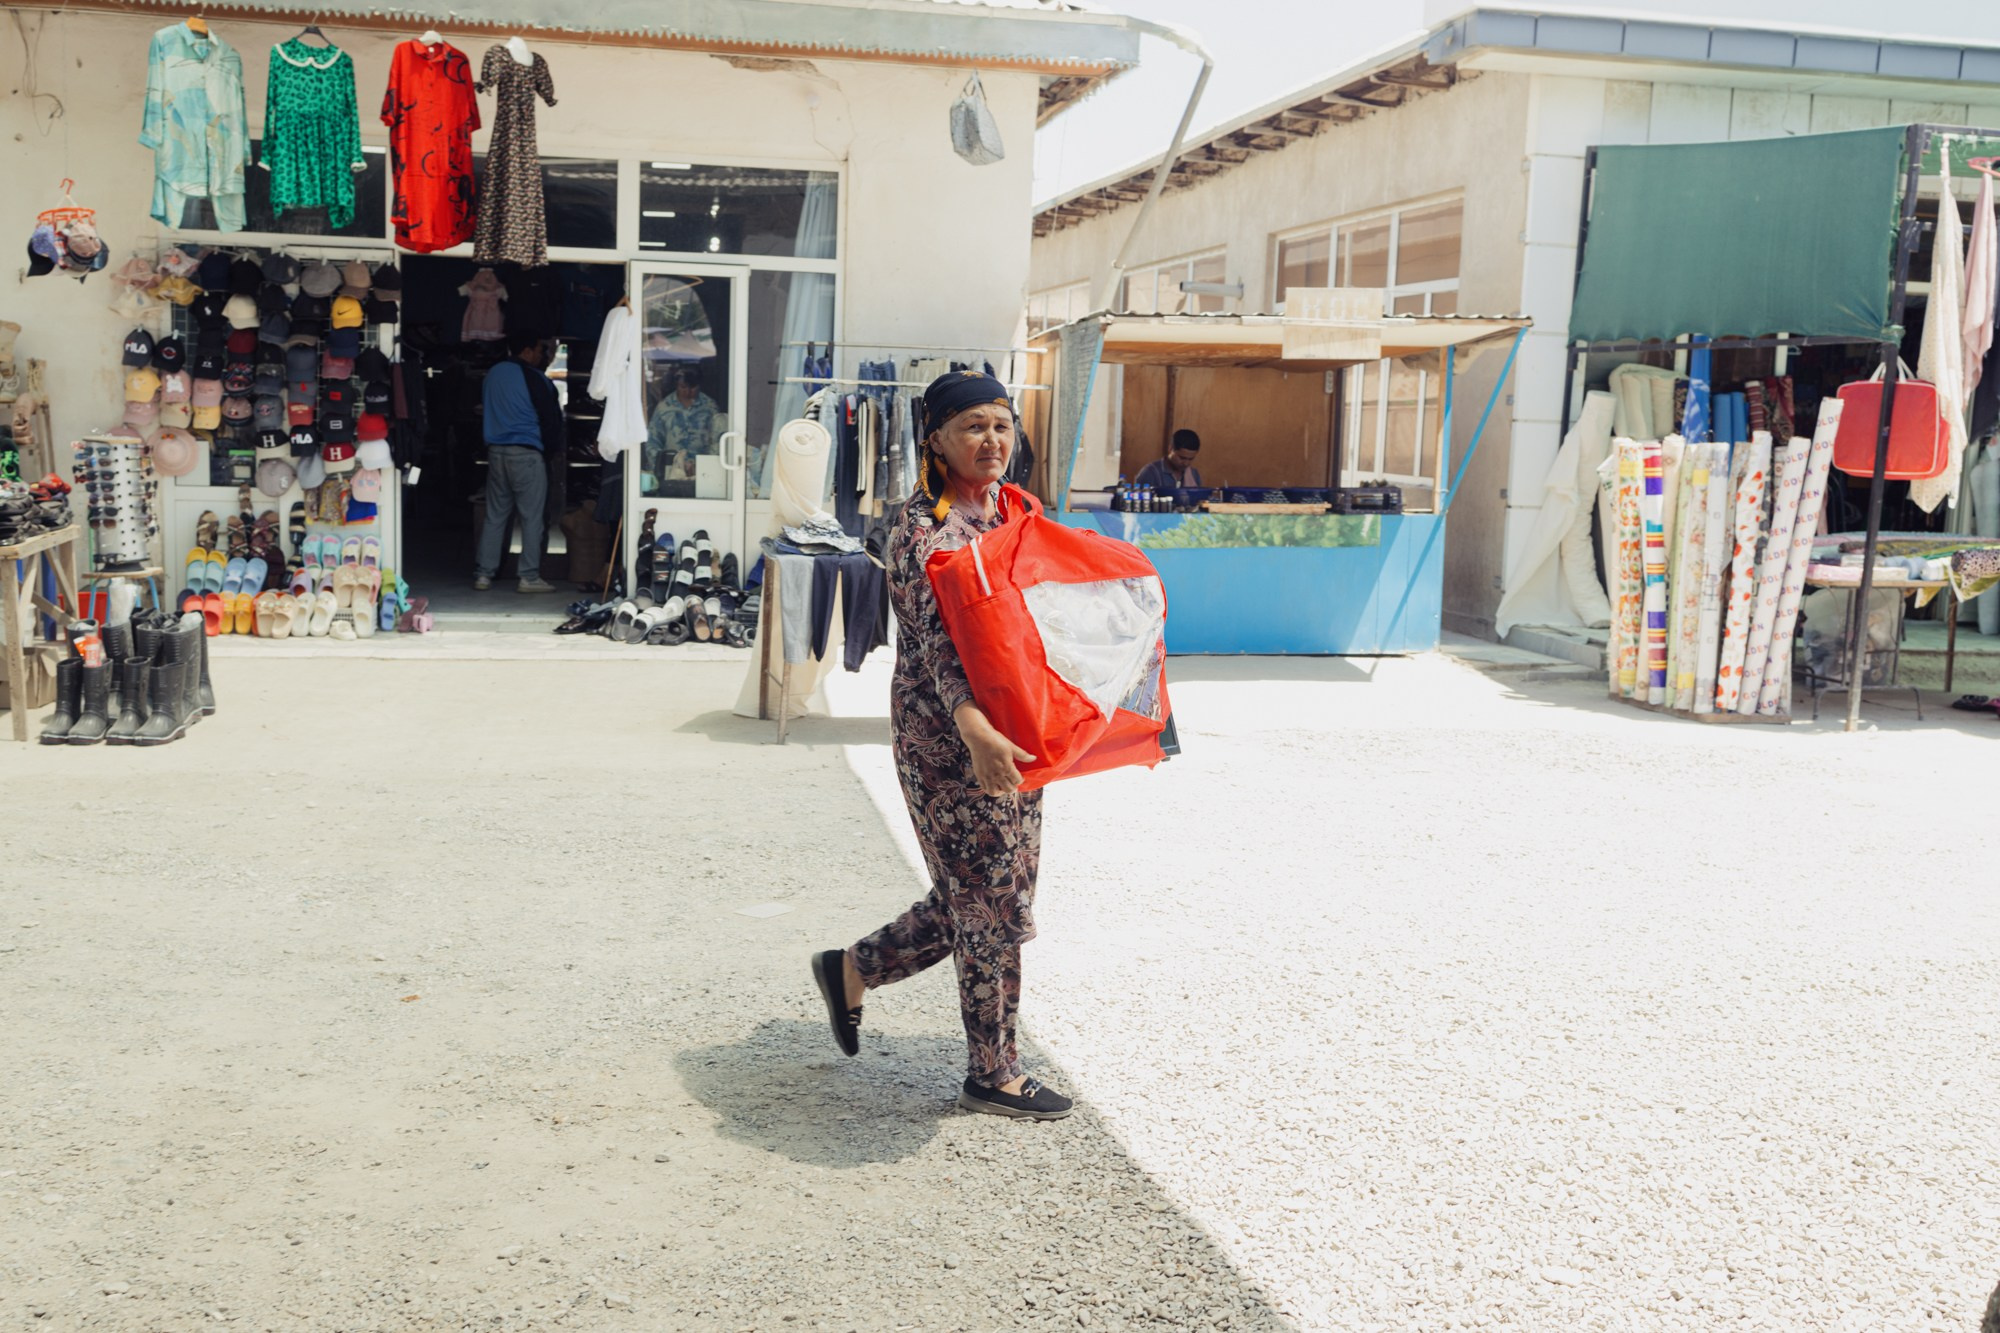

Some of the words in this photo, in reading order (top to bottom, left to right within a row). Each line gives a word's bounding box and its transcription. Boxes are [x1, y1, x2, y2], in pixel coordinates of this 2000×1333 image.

[125, 339, 148, 354] FILA
[262, 434, 276, 448] H
[290, 433, 313, 445] FILA
[329, 446, 342, 460] H
